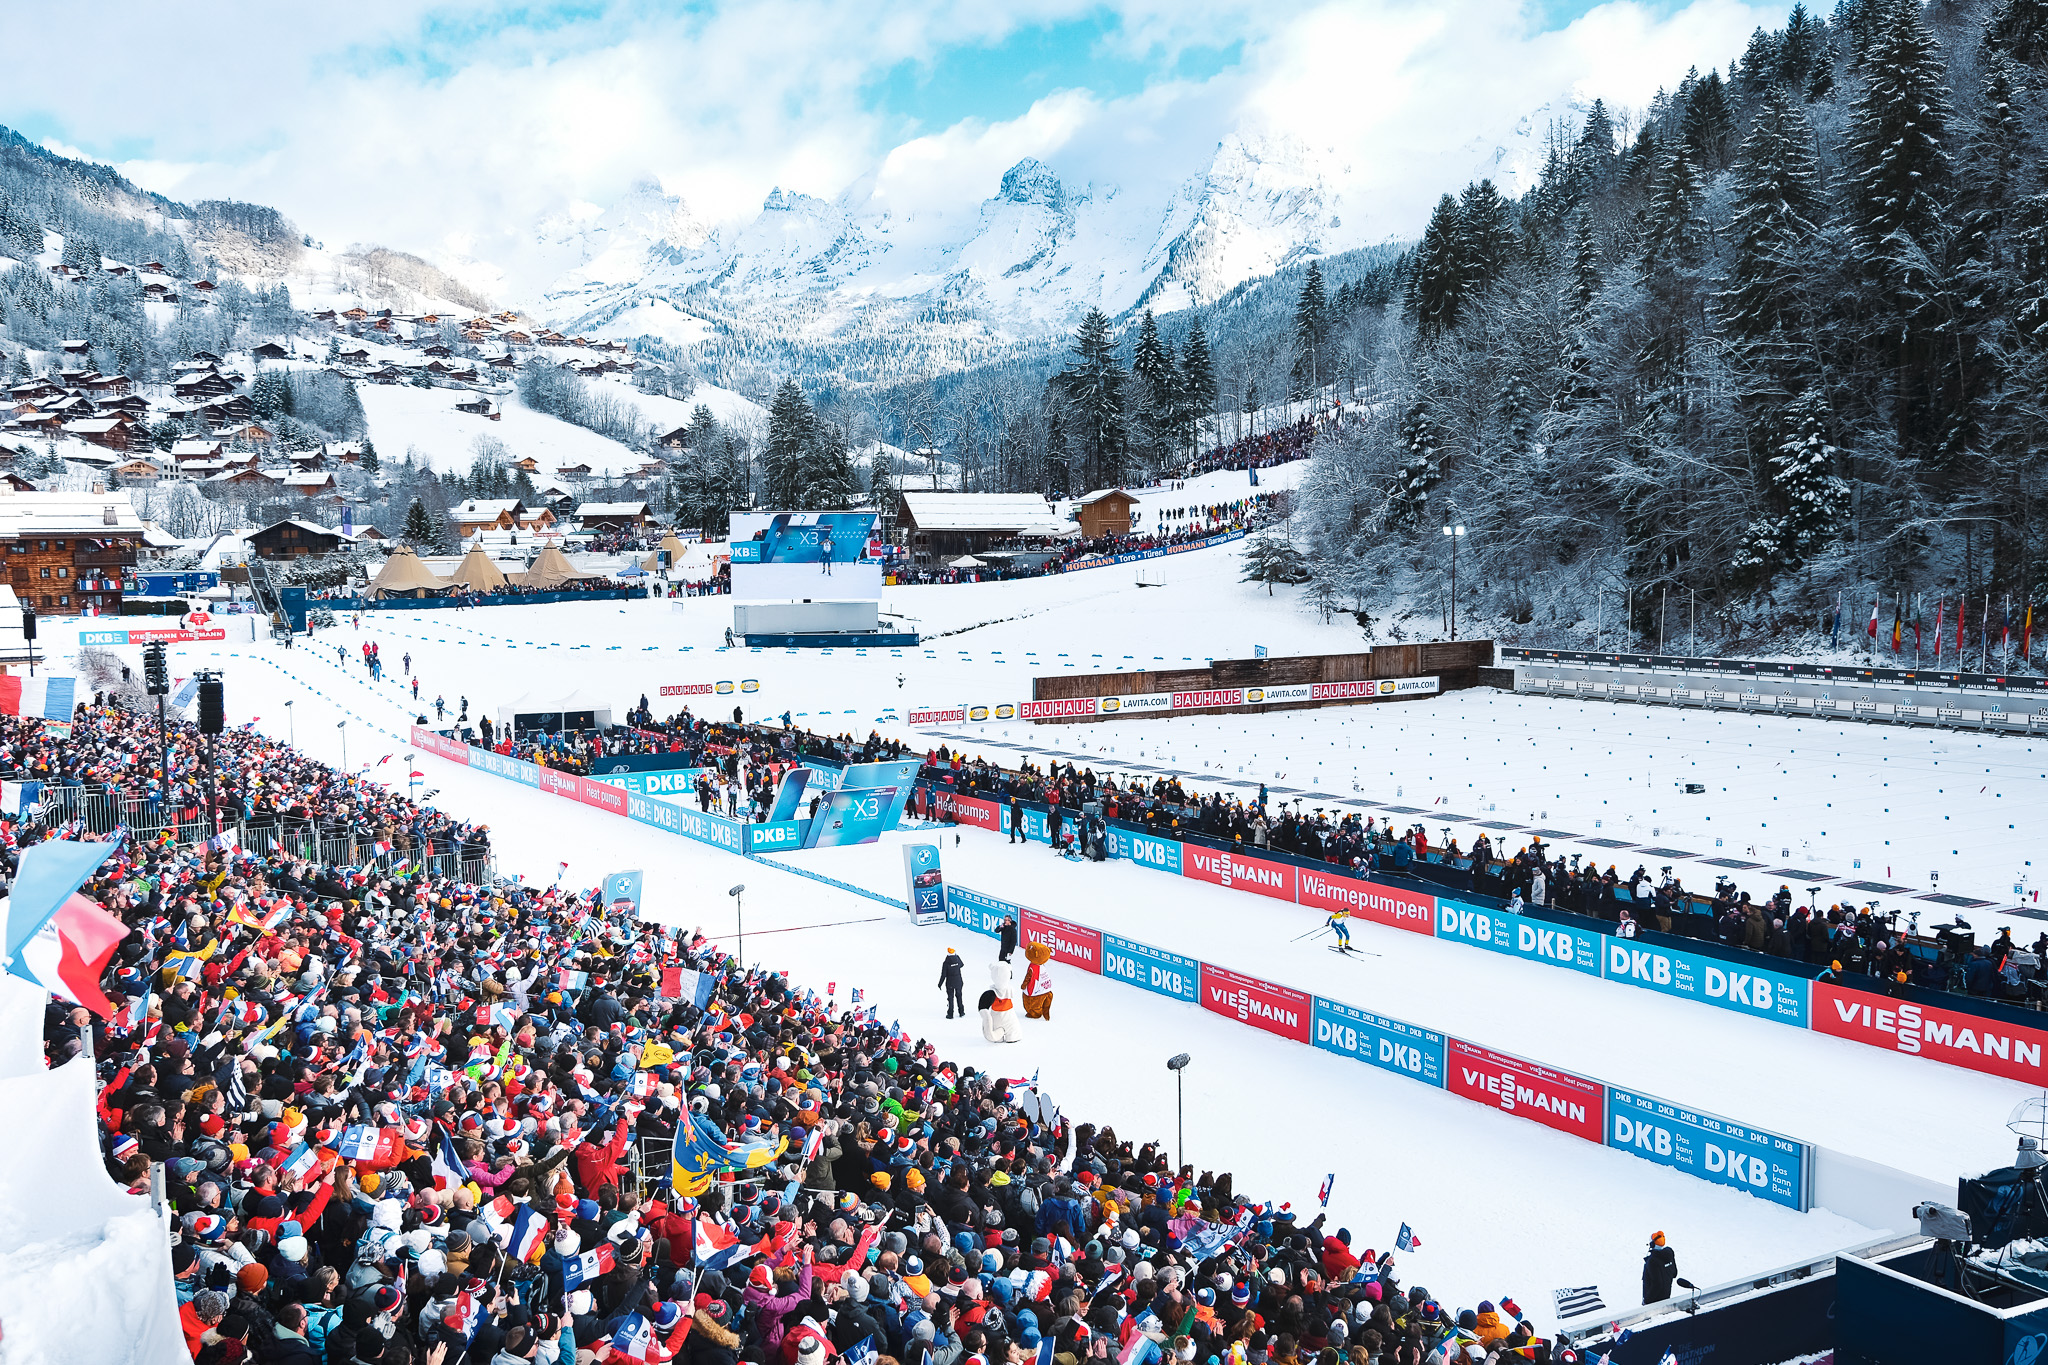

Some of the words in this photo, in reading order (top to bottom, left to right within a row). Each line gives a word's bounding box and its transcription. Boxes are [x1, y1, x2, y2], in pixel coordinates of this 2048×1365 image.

[800, 532, 818, 544] X3
[1119, 553, 1136, 563] Tore
[1143, 549, 1163, 559] Türen
[1208, 536, 1226, 546] Garage
[1228, 531, 1244, 540] Doors
[86, 633, 113, 643] DKB
[660, 684, 712, 696] BAUHAUS
[1266, 689, 1307, 698] LAVITA.COM
[1312, 682, 1374, 699] BAUHAUS
[1398, 681, 1435, 690] LAVITA.COM
[1123, 698, 1168, 708] LAVITA.COM
[1173, 690, 1241, 708] BAUHAUS
[910, 710, 964, 724] BAUHAUS
[1021, 699, 1095, 718] BAUHAUS
[470, 750, 480, 765] DKB
[486, 754, 496, 771] DKB
[503, 759, 514, 777] DKB
[521, 764, 533, 782] DKB
[542, 772, 576, 794] VIESSMANN
[646, 774, 686, 792] DKB
[586, 784, 600, 799] Heat
[601, 792, 621, 808] pumps
[629, 797, 646, 818] DKB
[654, 804, 671, 827] DKB
[854, 798, 879, 817] X3
[958, 803, 990, 822] pumps
[682, 813, 701, 837] DKB
[1004, 810, 1029, 835] DB
[711, 822, 731, 846] DKB
[753, 828, 785, 843] DKB
[1133, 838, 1165, 865] DKB
[1193, 854, 1283, 888] VIESSMANN
[921, 893, 938, 906] X3
[1303, 874, 1428, 922] Wärmepumpen
[948, 902, 971, 924] DKB
[1441, 906, 1492, 942] DKB
[1494, 918, 1506, 929] Das
[1494, 927, 1510, 939] kann
[1027, 929, 1092, 961] VIESSMANN
[1494, 936, 1510, 948] Bank
[1518, 924, 1574, 962] DKB
[1577, 937, 1590, 948] Das
[1577, 946, 1594, 959] kann
[1106, 952, 1136, 979] DKB
[1577, 956, 1594, 968] Bank
[1610, 945, 1672, 985] DKB
[1675, 960, 1690, 971] Das
[1151, 965, 1182, 994] DKB
[1675, 970, 1694, 982] kann
[1675, 980, 1694, 993] Bank
[1705, 966, 1773, 1010] DKB
[1778, 983, 1794, 995] Das
[1210, 986, 1298, 1028] VIESSMANN
[1778, 994, 1798, 1007] kann
[1778, 1004, 1799, 1018] Bank
[1318, 999, 1330, 1009] DKB
[1333, 1004, 1344, 1014] DKB
[1348, 1008, 1359, 1018] DKB
[1363, 1012, 1375, 1022] DKB
[1378, 1017, 1390, 1028] DKB
[1394, 1022, 1406, 1032] DKB
[1410, 1027, 1422, 1038] DKB
[1426, 1032, 1438, 1043] DKB
[1318, 1018, 1357, 1052] DKB
[1360, 1031, 1370, 1041] Das
[1833, 999, 2041, 1068] VIESSMANN
[1360, 1039, 1372, 1050] kann
[1360, 1047, 1372, 1058] Bank
[1379, 1037, 1422, 1074] DKB
[1424, 1052, 1435, 1062] Das
[1424, 1061, 1438, 1072] kann
[1424, 1069, 1438, 1080] Bank
[1456, 1042, 1482, 1055] VIESSMANN
[1488, 1052, 1523, 1068] Wärmepumpen
[1529, 1065, 1557, 1079] VIESSMANN
[1564, 1076, 1575, 1084] Heat
[1576, 1079, 1594, 1091] pumps
[1462, 1066, 1585, 1124] VIESSMANN
[1616, 1092, 1631, 1103] DKB
[1636, 1098, 1653, 1110] DKB
[1658, 1105, 1674, 1116] DKB
[1681, 1111, 1697, 1123] DKB
[1703, 1118, 1720, 1130] DKB
[1726, 1125, 1744, 1137] DKB
[1750, 1132, 1768, 1144] DKB
[1775, 1140, 1793, 1152] DKB
[1615, 1114, 1672, 1156] DKB
[1676, 1134, 1690, 1145] Das
[1676, 1143, 1693, 1156] kann
[1676, 1153, 1694, 1165] Bank
[1705, 1143, 1768, 1188] DKB
[1772, 1164, 1787, 1176] Das
[1772, 1174, 1792, 1187] kann
[1772, 1184, 1792, 1197] Bank
[1677, 1344, 1716, 1361] BIATHLON
[1678, 1342, 1692, 1351] THE
